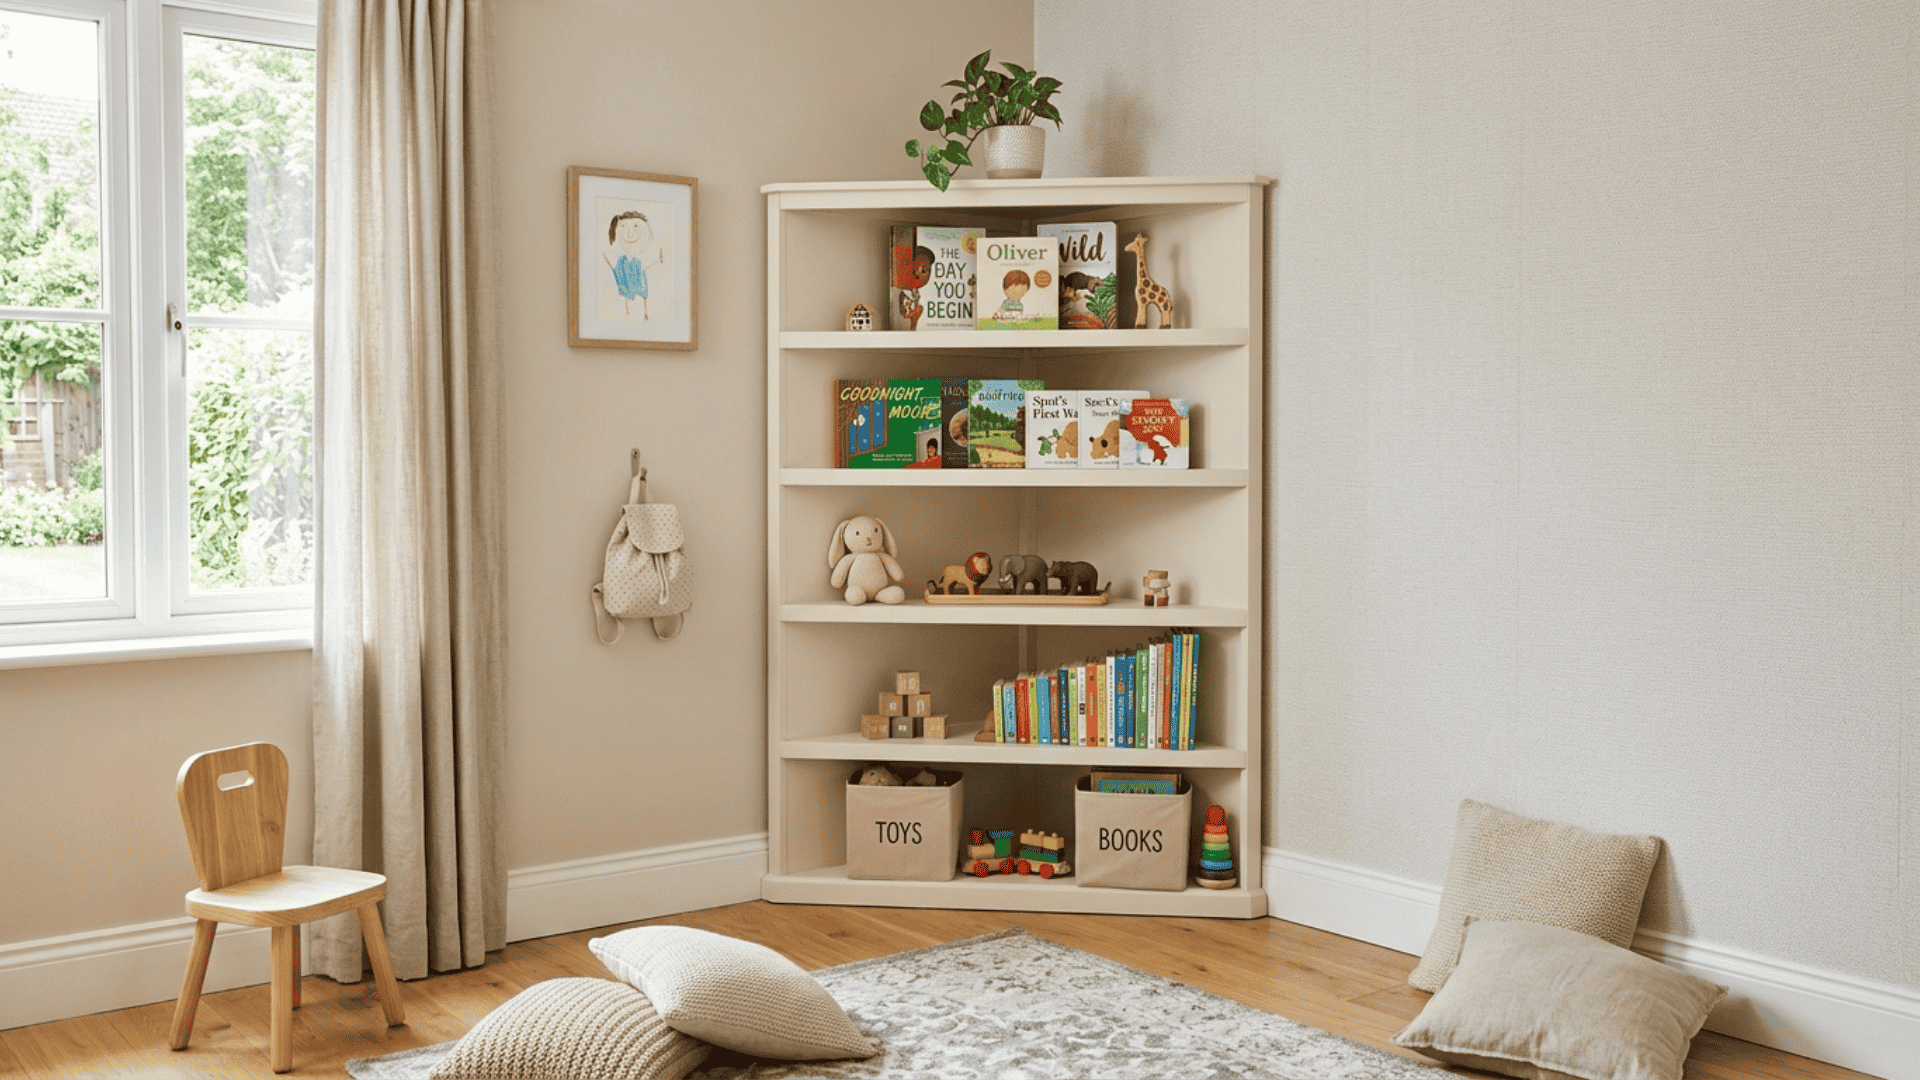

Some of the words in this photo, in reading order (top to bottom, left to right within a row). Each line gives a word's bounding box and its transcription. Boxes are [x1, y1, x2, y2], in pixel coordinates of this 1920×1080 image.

[940, 247, 960, 259] THE
[987, 243, 1048, 261] Oliver
[934, 262, 966, 279] DAY
[934, 281, 966, 299] YOU
[927, 301, 974, 319] BEGIN
[840, 386, 924, 402] GOODNIGHT
[875, 821, 922, 845] TOYS
[1099, 827, 1163, 853] BOOKS
